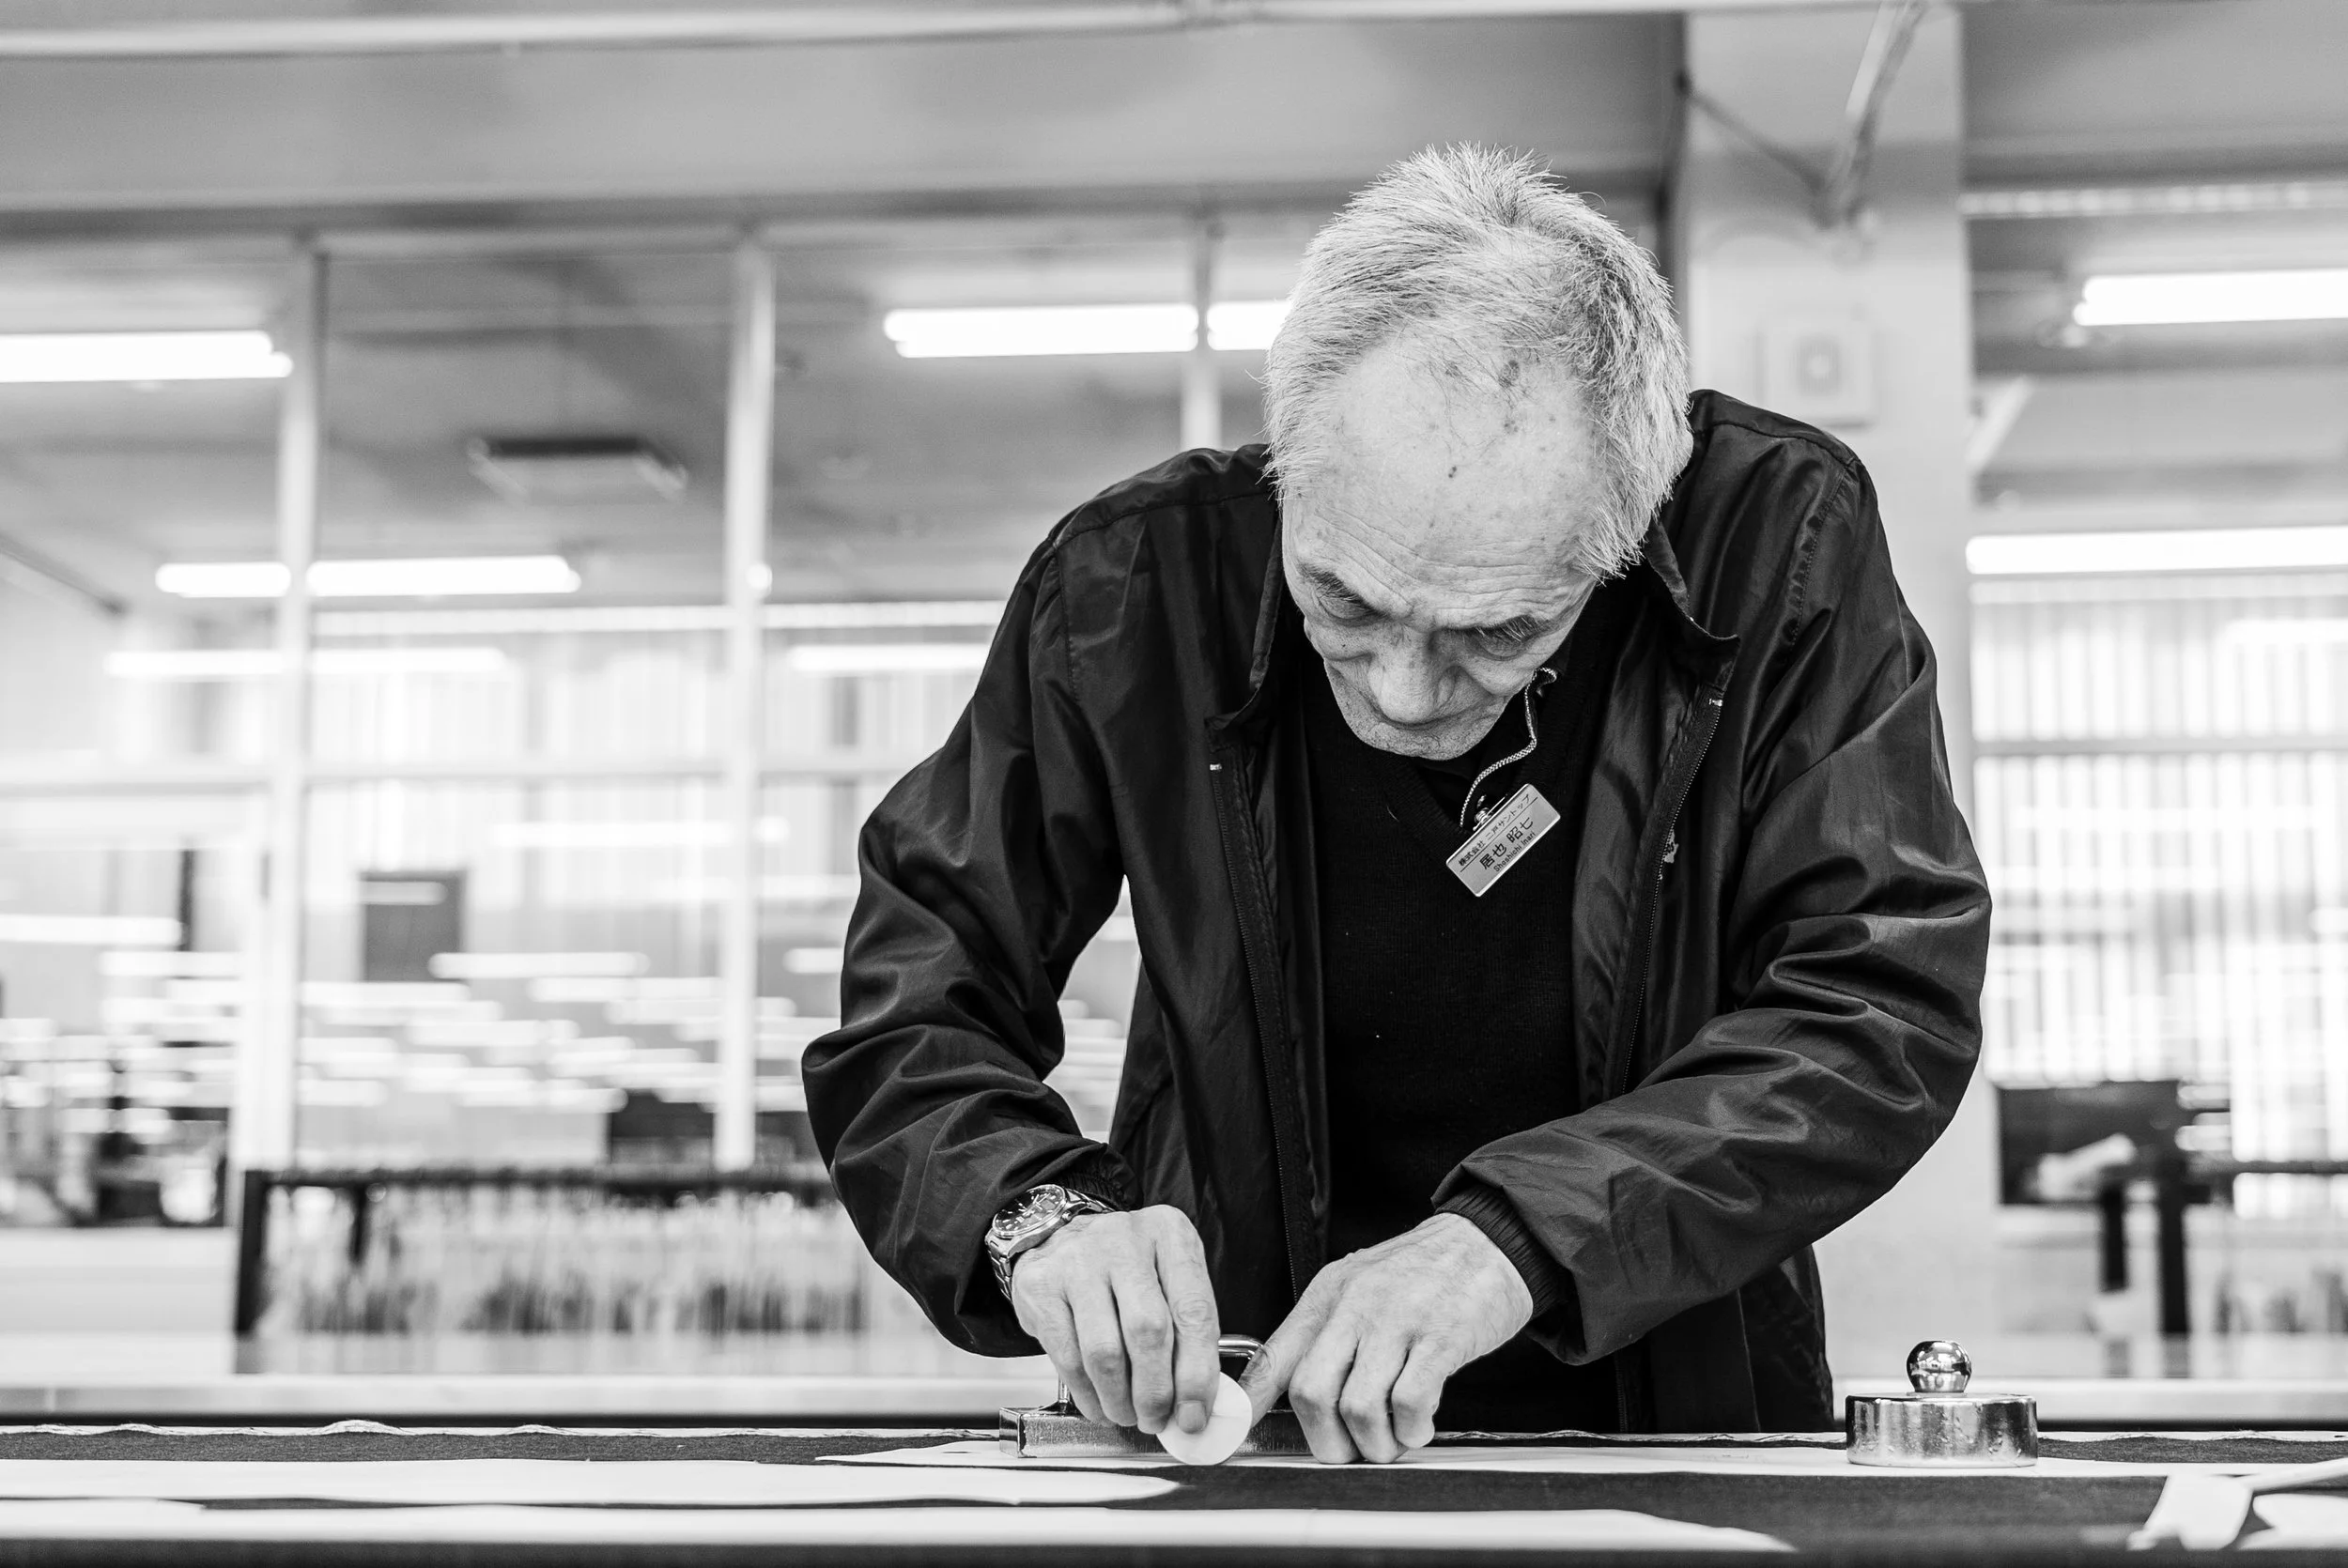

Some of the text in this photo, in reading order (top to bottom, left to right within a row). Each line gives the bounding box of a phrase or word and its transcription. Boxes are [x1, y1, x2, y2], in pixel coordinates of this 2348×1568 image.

[1479, 817, 1534, 869] 居也 昭七
[1493, 830, 1537, 872] Shoshichi Inari
